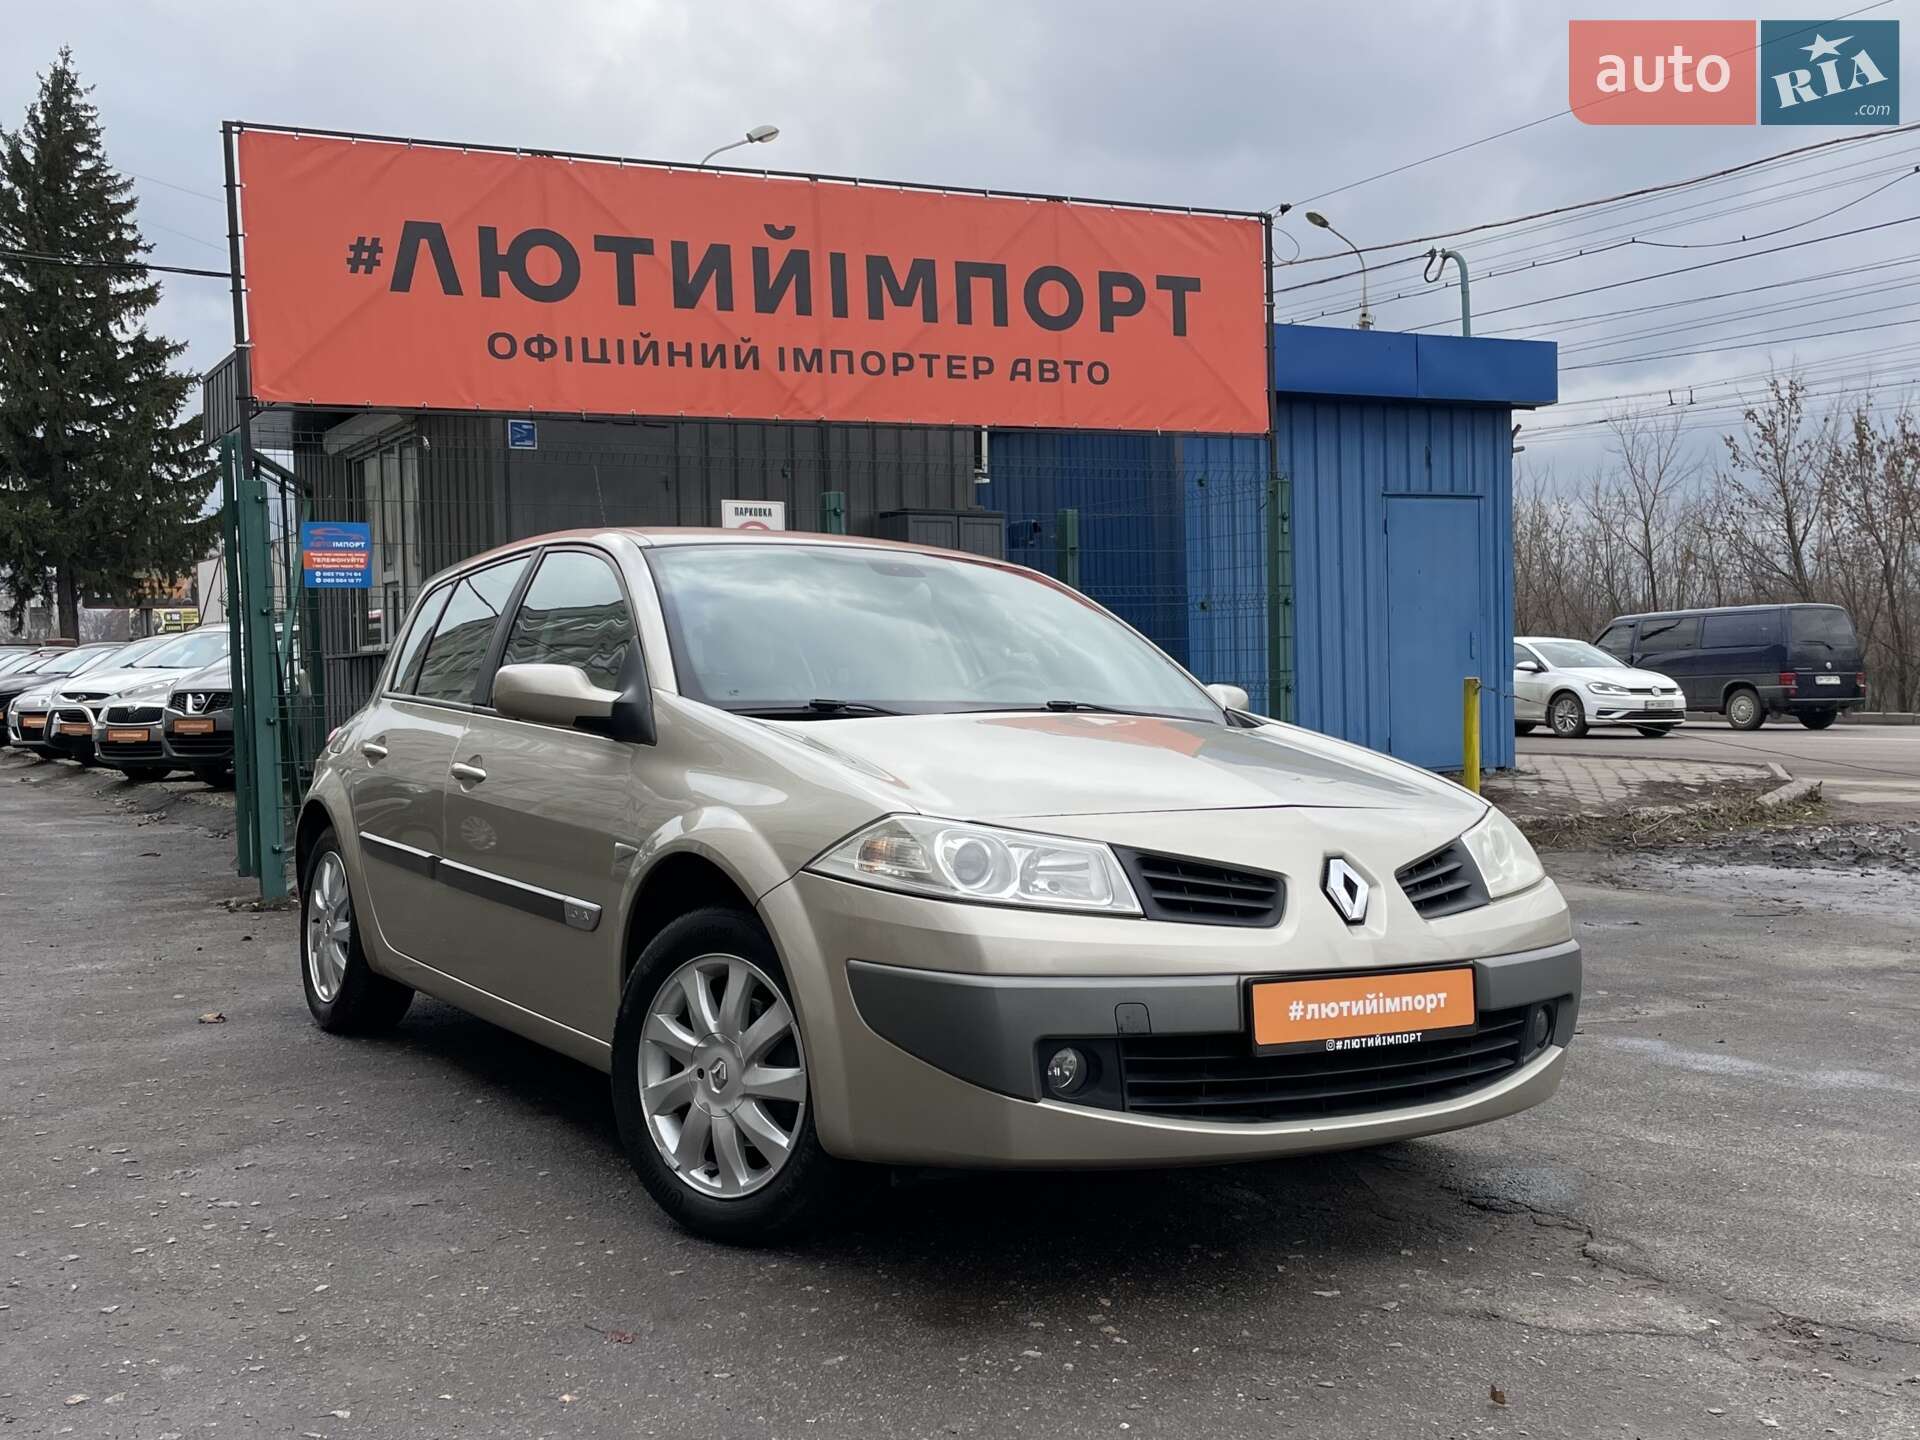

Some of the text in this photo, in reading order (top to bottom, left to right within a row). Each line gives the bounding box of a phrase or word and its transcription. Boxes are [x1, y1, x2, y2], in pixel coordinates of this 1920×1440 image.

[346, 220, 1201, 336] #ЛЮТИЙІМПОРТ
[487, 331, 1110, 385] ОФІЦІЙНИЙ ІМПОРТЕР АВТО
[734, 507, 772, 517] ПАРКОВКА
[1288, 991, 1449, 1022] #лютийімпорт
[1335, 1032, 1423, 1050] #ЛЮТИЙІМПОРТ
